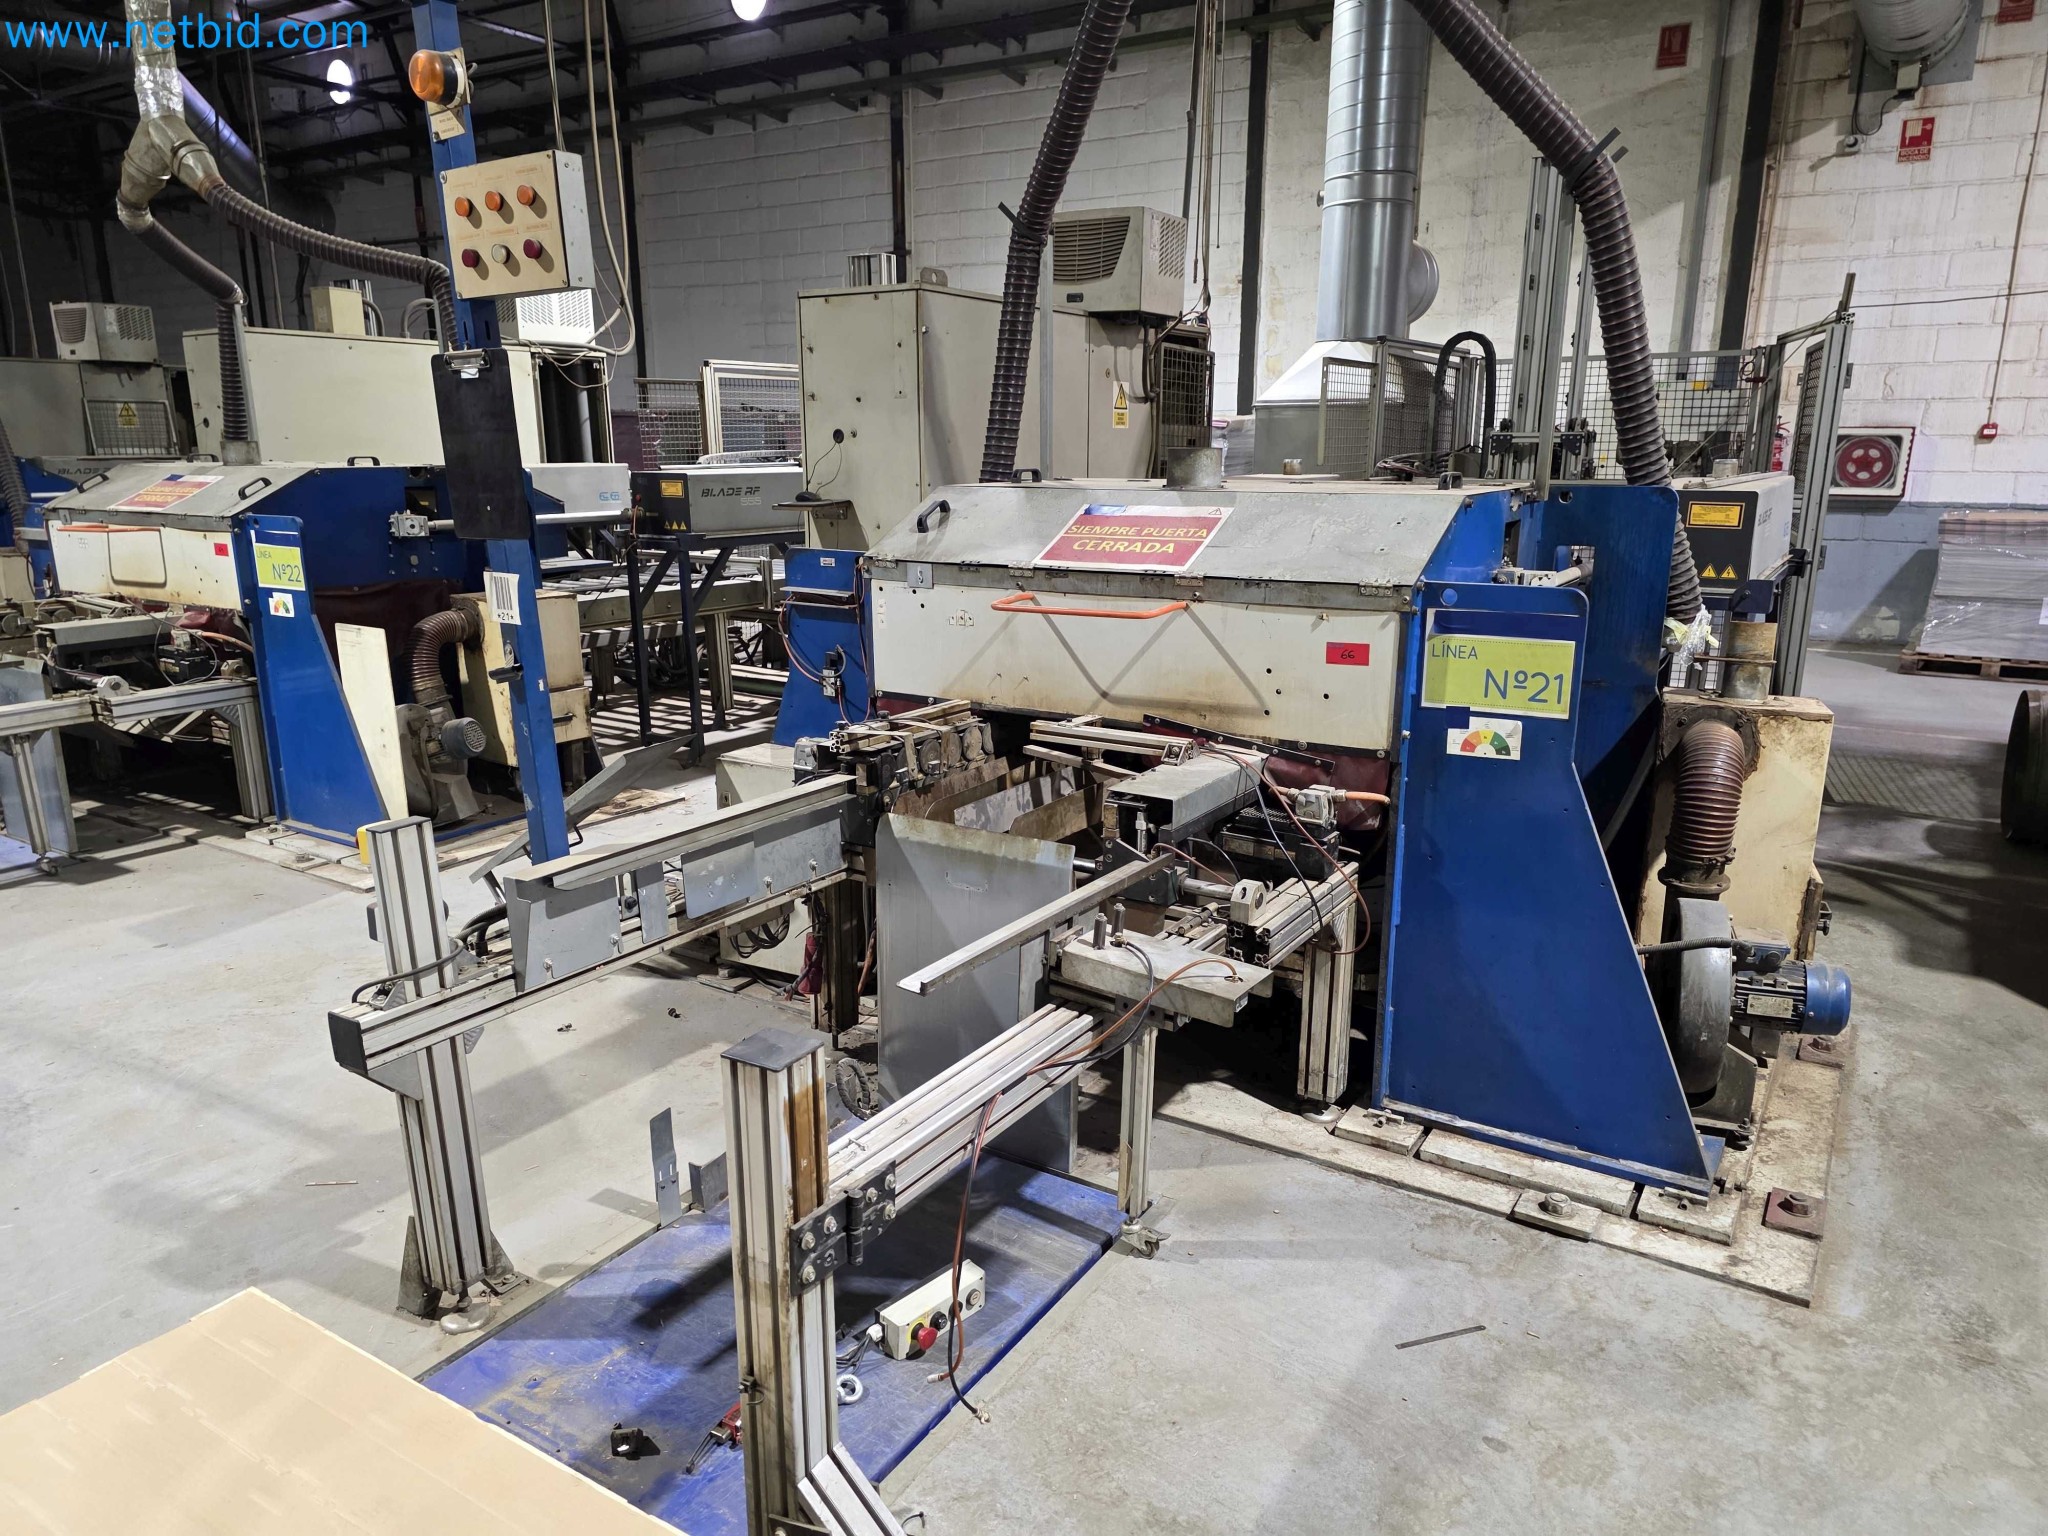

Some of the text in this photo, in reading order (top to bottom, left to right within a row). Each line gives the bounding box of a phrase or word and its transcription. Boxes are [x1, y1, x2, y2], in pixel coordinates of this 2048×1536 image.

[701, 486, 761, 498] BLADE RF
[1068, 525, 1208, 538] SIEMPRE PUERTA
[1073, 539, 1175, 553] CERRADA
[1340, 649, 1356, 660] 66
[1432, 640, 1479, 660] LÍNEA
[1483, 668, 1564, 705] Nº21
